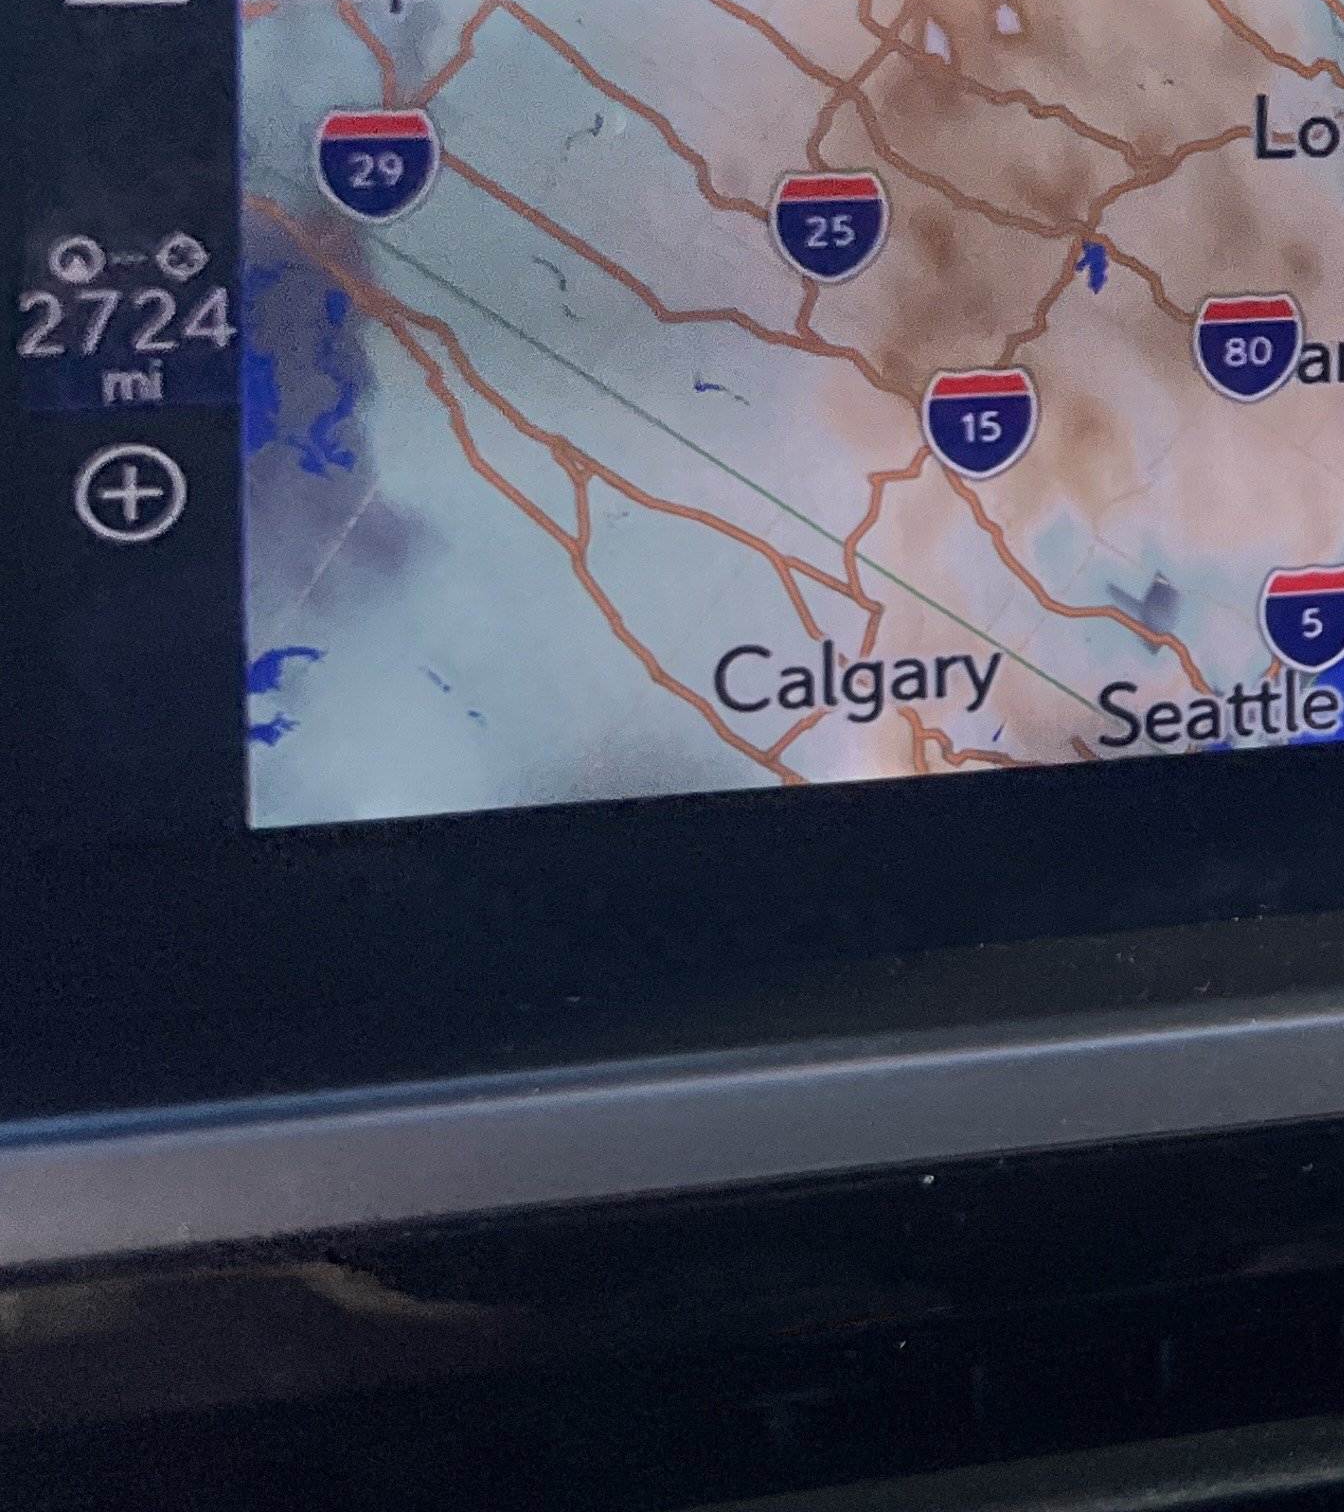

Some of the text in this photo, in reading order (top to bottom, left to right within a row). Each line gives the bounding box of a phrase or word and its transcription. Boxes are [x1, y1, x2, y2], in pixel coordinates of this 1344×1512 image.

[348, 152, 403, 188] 29
[807, 214, 856, 248] 25
[17, 289, 236, 358] 2724
[1224, 336, 1273, 367] 80
[101, 360, 164, 405] mi
[962, 411, 1001, 444] 15
[1302, 610, 1323, 638] 5
[714, 639, 1001, 721] Calgary
[1100, 674, 1340, 747] Seattle
